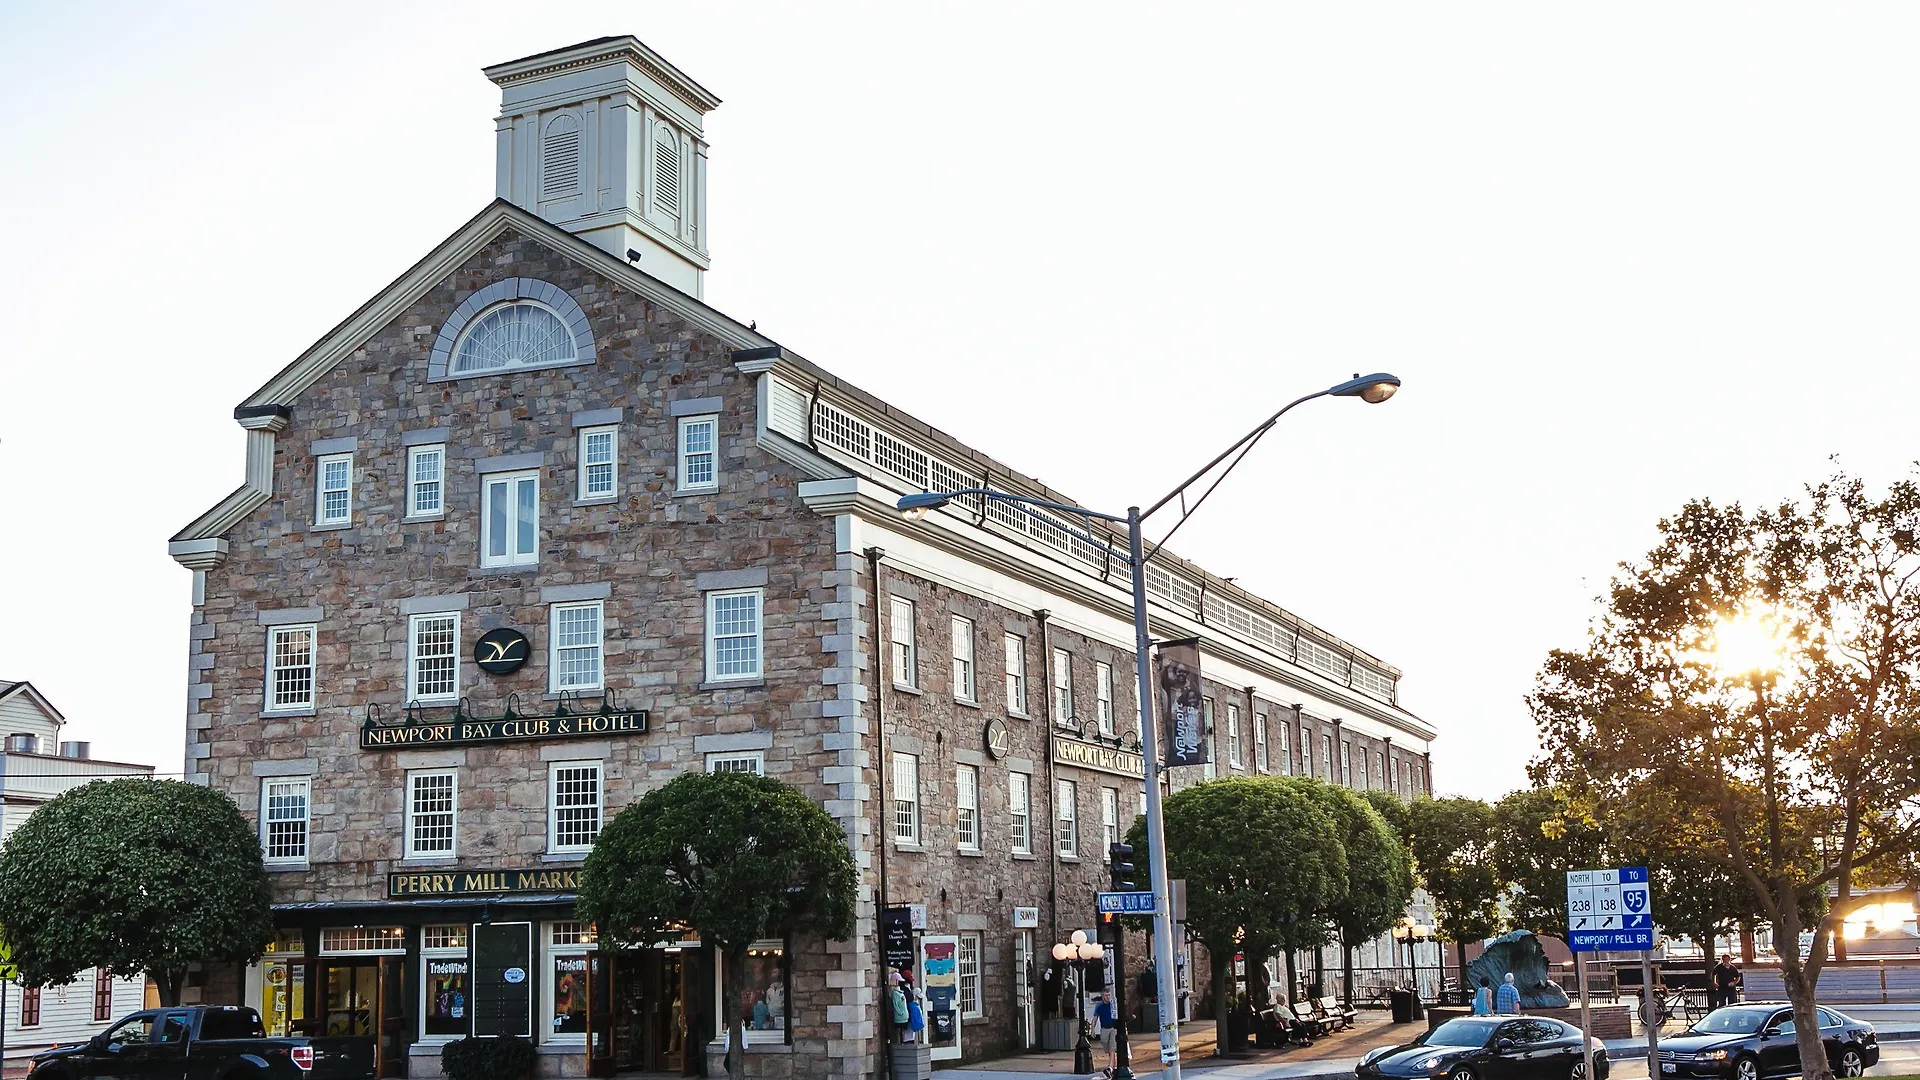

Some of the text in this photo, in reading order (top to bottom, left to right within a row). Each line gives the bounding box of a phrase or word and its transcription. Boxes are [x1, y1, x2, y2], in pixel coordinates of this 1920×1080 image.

[368, 714, 638, 745] NEWPORT BAY CLUB & HOTEL
[1175, 703, 1186, 760] Newport
[1056, 741, 1098, 765] NEWPORT
[1099, 751, 1115, 768] BAY
[1116, 754, 1136, 773] CLUB
[397, 870, 583, 893] PERRY MILL MARKE
[1570, 874, 1590, 883] NORTH
[1602, 873, 1611, 882] TO
[1629, 871, 1639, 880] TO
[1126, 895, 1137, 909] BLVD
[1140, 894, 1152, 909] WEST
[1571, 900, 1591, 912] 238
[1600, 899, 1616, 911] 138
[1627, 891, 1643, 908] 95
[1615, 934, 1633, 943] PELL
[1637, 934, 1649, 943] BR.
